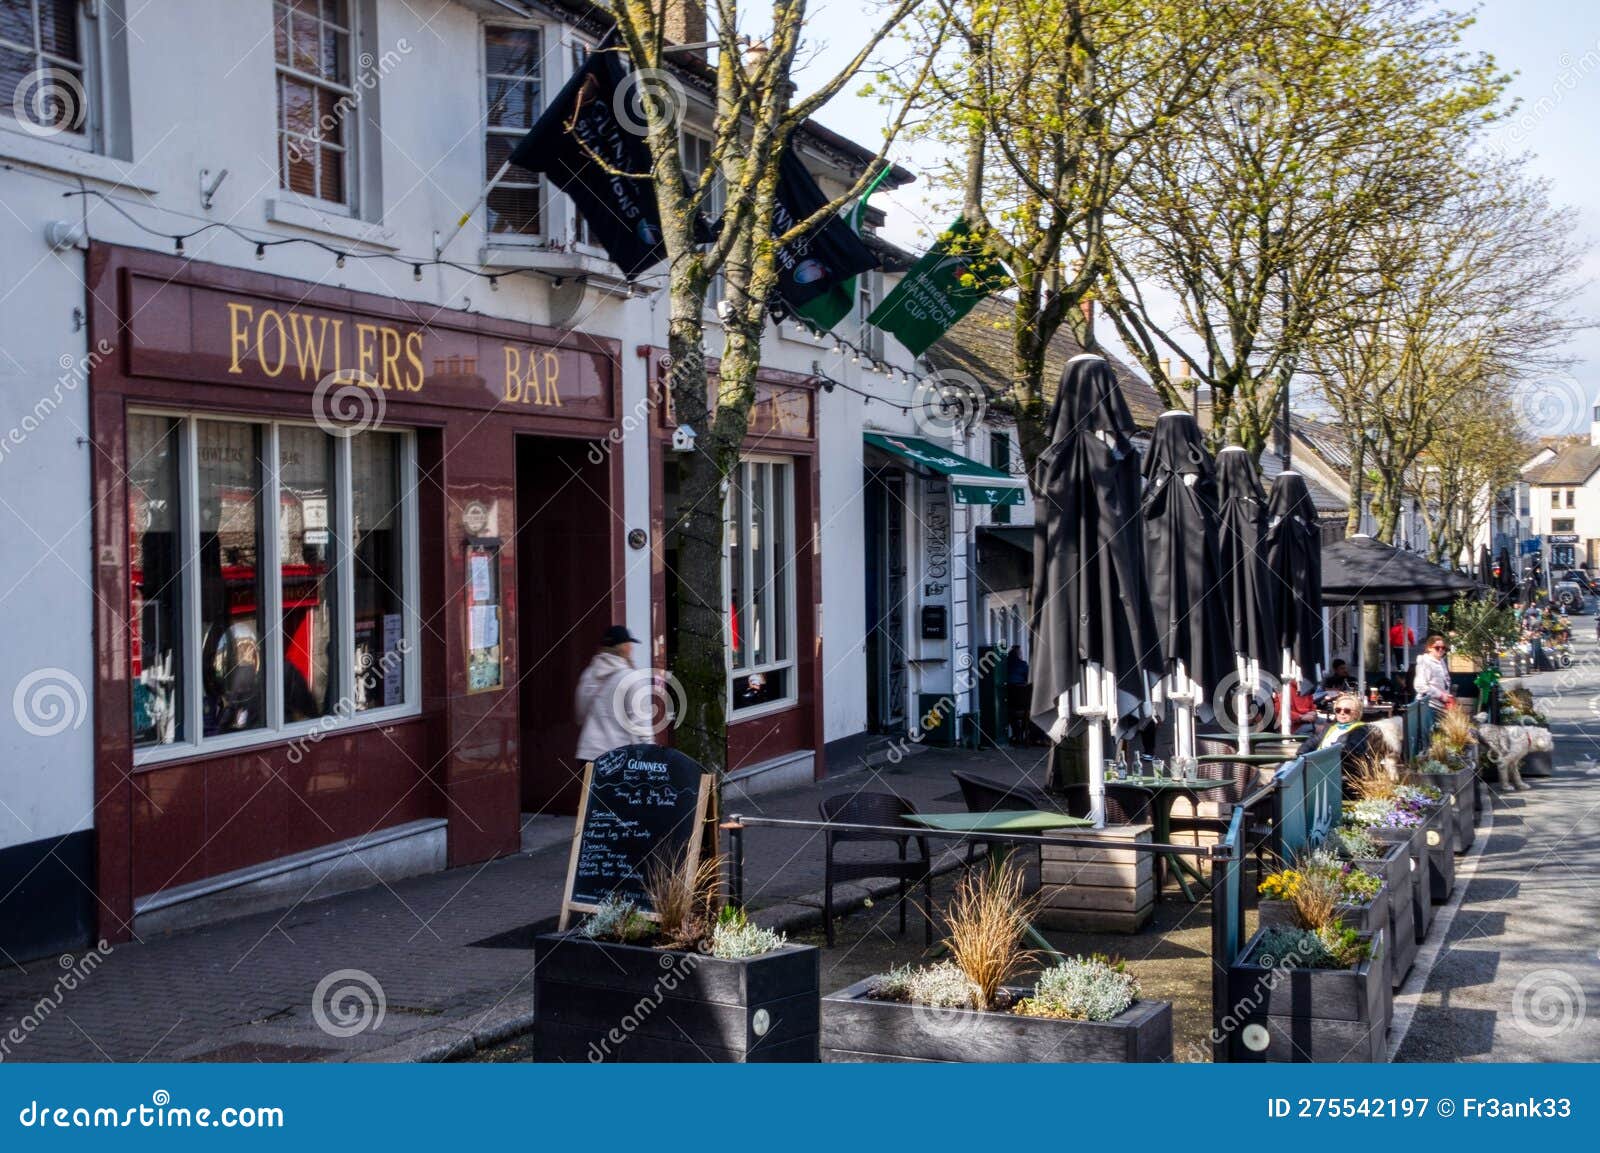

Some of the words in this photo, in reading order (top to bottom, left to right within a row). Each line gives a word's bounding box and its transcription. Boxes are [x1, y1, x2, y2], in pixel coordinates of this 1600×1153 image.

[904, 299, 928, 320] CUP
[227, 302, 425, 393] FOWLERS
[503, 346, 562, 408] BAR
[627, 758, 668, 773] GUINNESS
